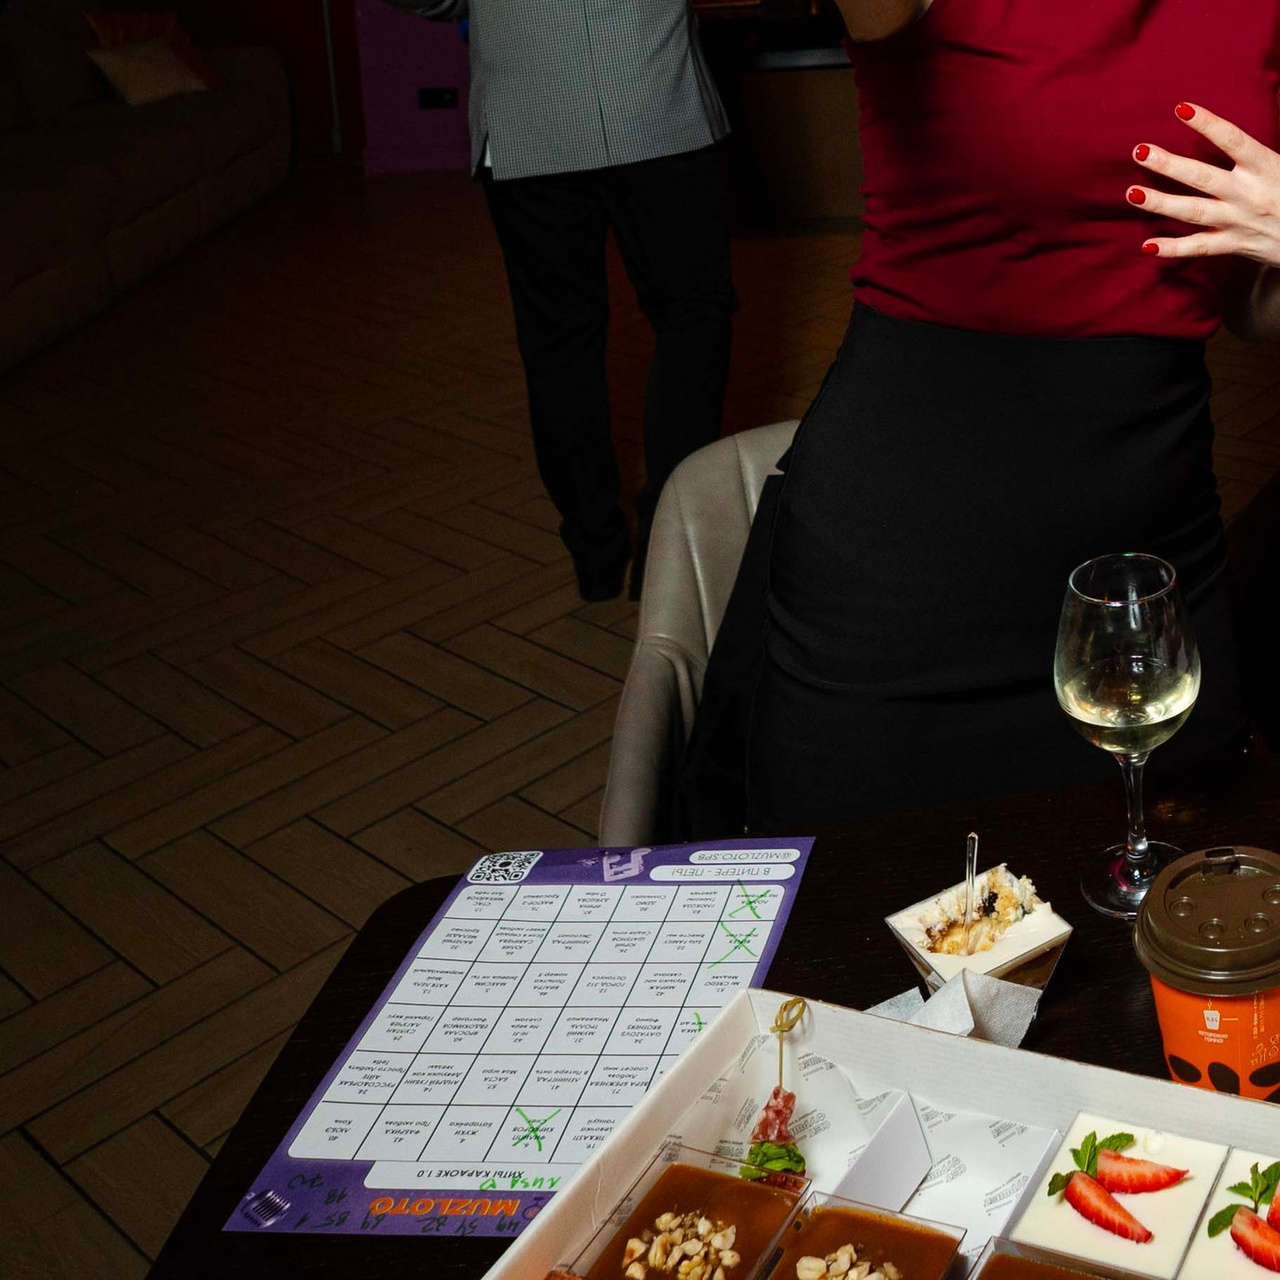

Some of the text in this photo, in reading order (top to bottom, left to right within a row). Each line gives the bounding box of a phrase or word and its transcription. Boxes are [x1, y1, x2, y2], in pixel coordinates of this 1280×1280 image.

[698, 851, 792, 861] @MUZLOTO.SPB
[671, 867, 771, 877] В ПИТЕРЕ ПЕТЬ!
[404, 1014, 434, 1022] Горький
[347, 1064, 377, 1072] Любить
[788, 1112, 826, 1136] ФУРШ
[808, 1120, 831, 1138] СЕТ
[925, 1156, 961, 1181] ФУРШ
[417, 1169, 525, 1179] ХИТЫ КАРАОКЕ 1.0
[369, 1197, 521, 1216] MUZLOTO
